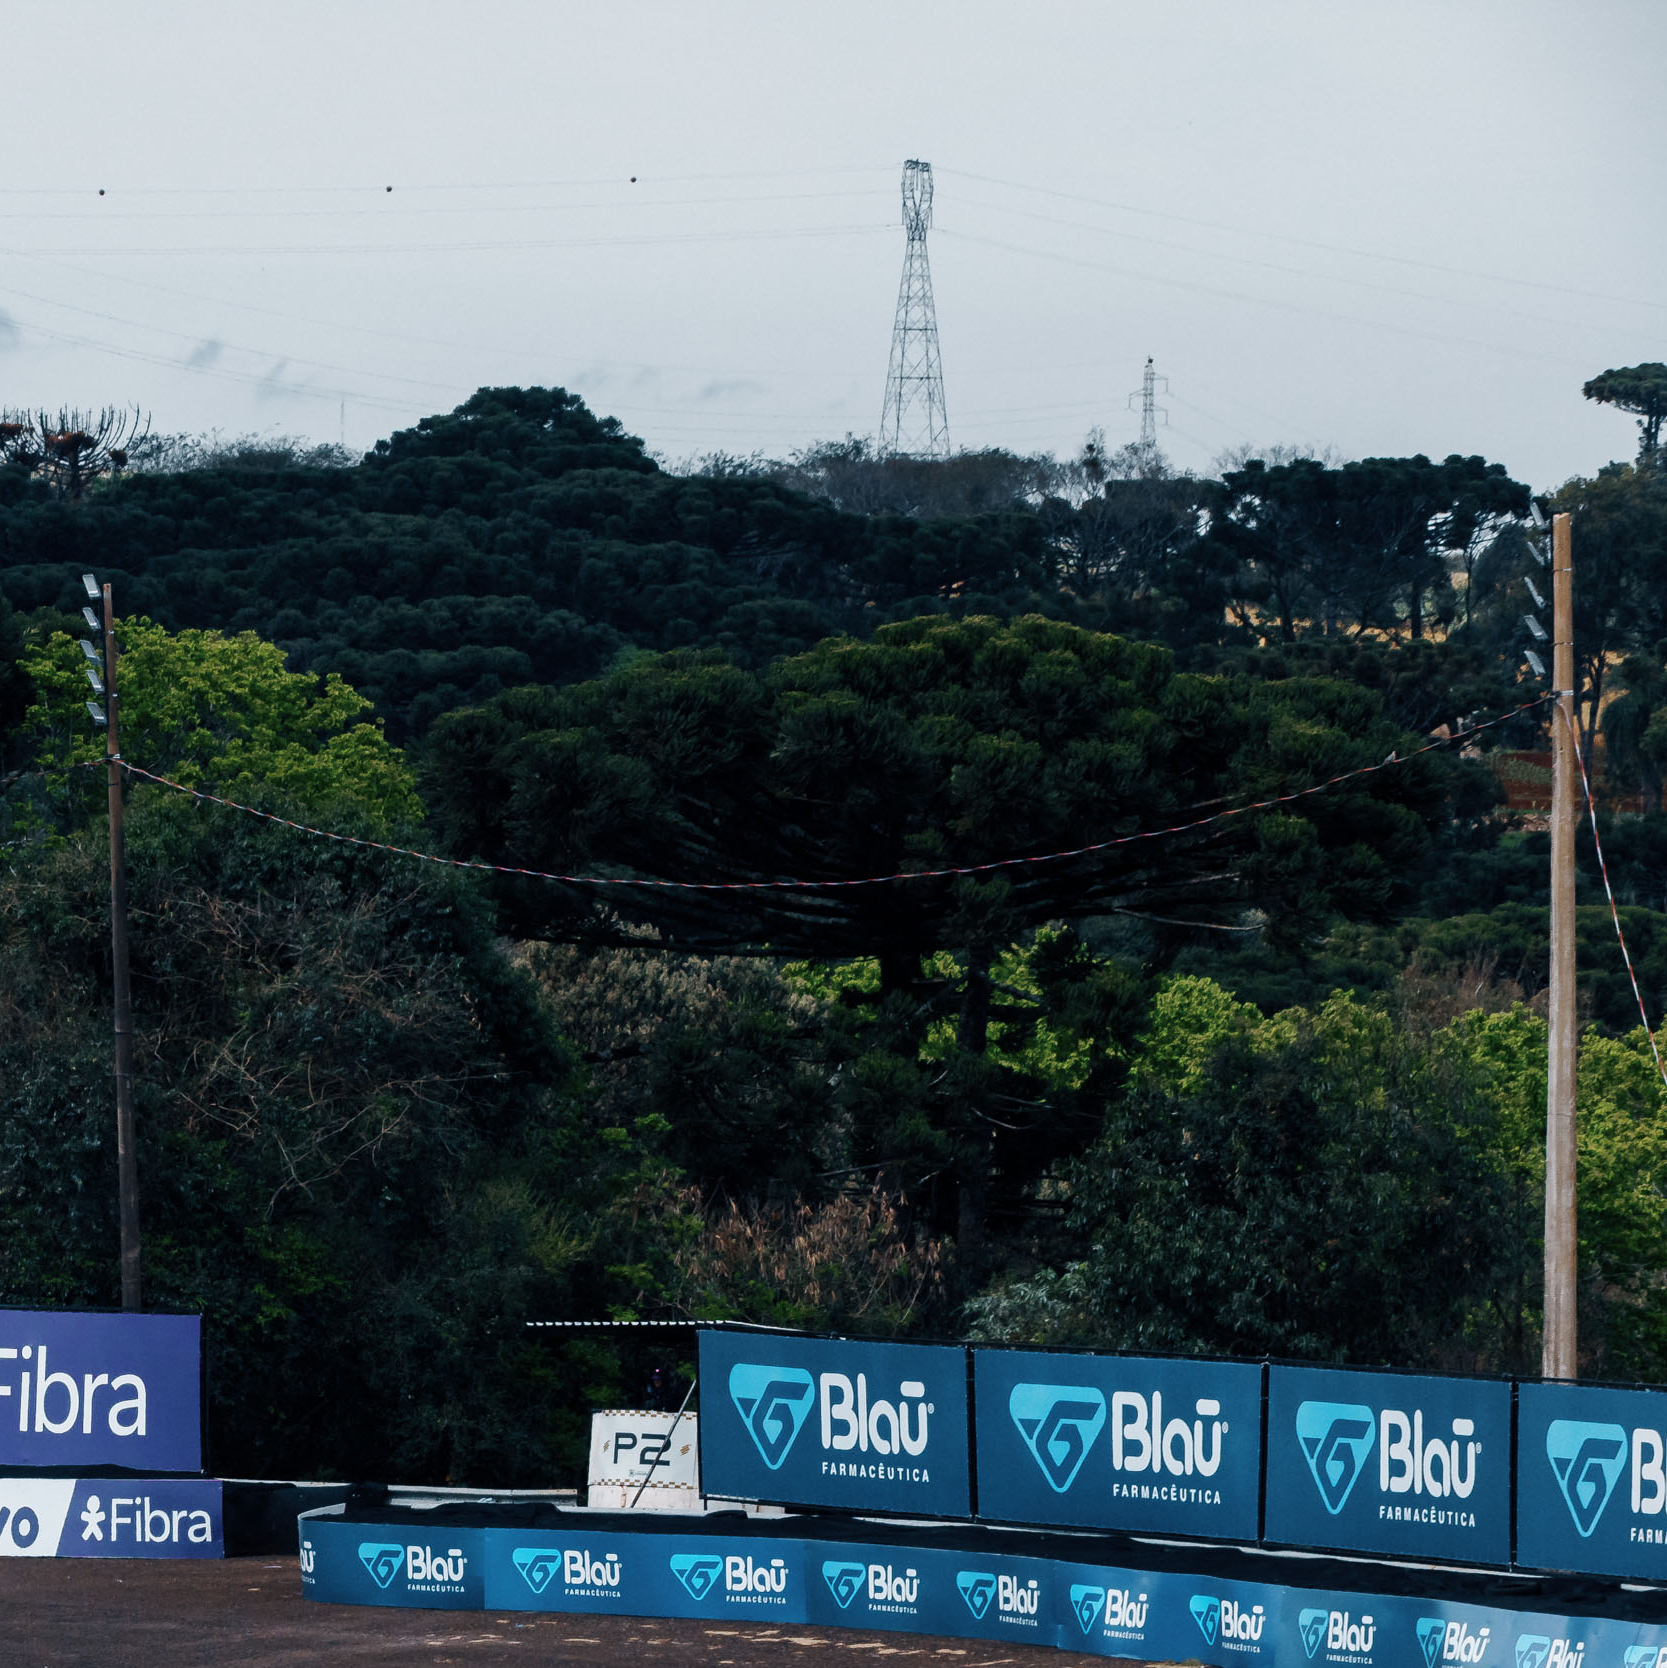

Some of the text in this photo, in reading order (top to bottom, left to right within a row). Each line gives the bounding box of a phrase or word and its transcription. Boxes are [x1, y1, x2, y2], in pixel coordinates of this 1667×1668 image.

[613, 1432, 672, 1467] P2
[822, 1461, 930, 1483] FARMACÊUTICA
[1113, 1482, 1222, 1505] FARMACÊUTICA
[109, 1496, 213, 1544] Fibra
[1379, 1505, 1476, 1528] FARMACÊUTICA
